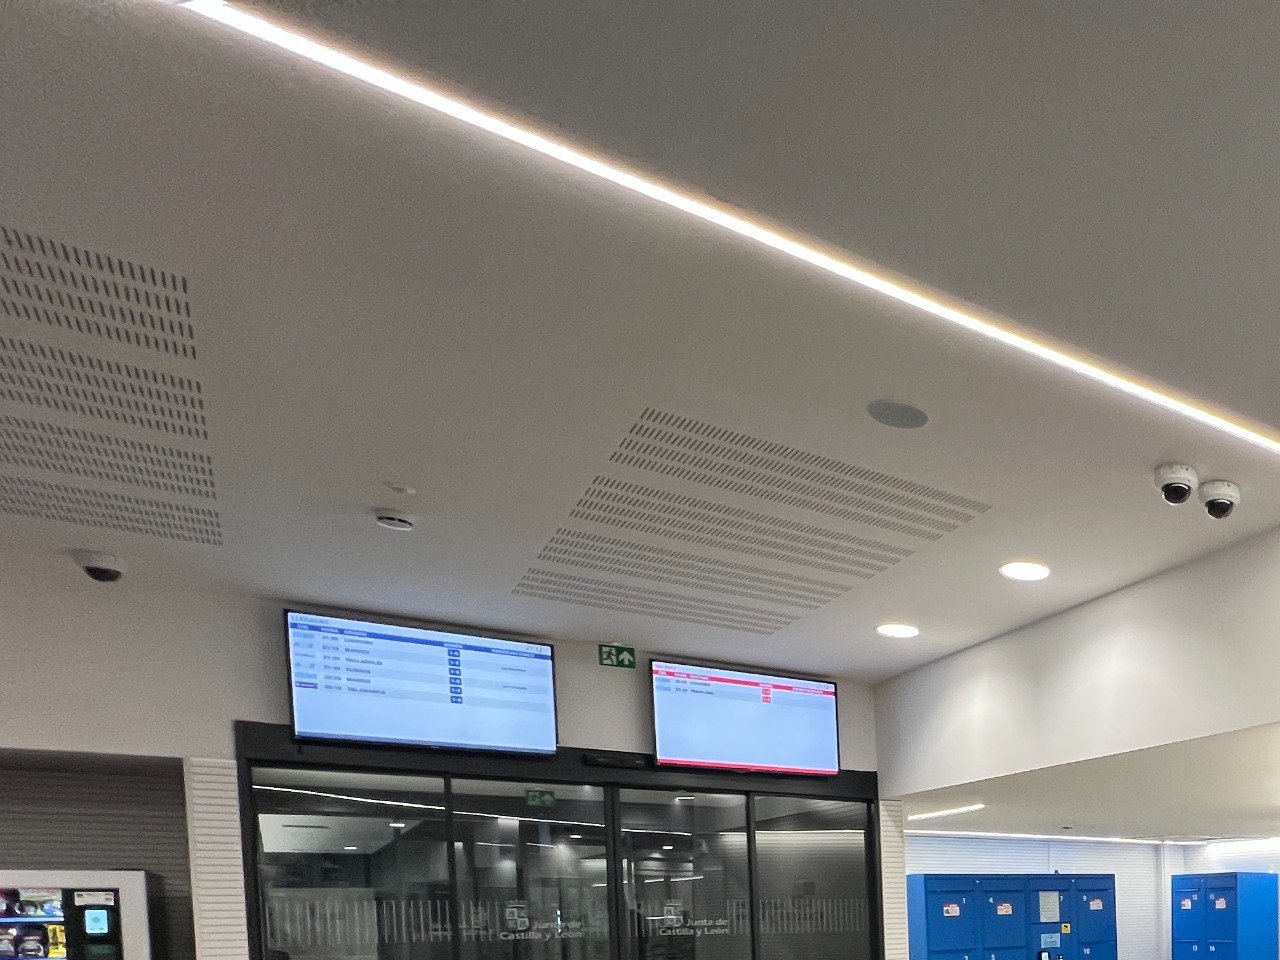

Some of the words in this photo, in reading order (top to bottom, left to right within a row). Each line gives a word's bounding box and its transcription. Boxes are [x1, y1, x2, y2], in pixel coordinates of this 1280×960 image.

[686, 918, 713, 926] Junta
[500, 931, 542, 940] Castilla
[659, 927, 693, 937] Castilla
